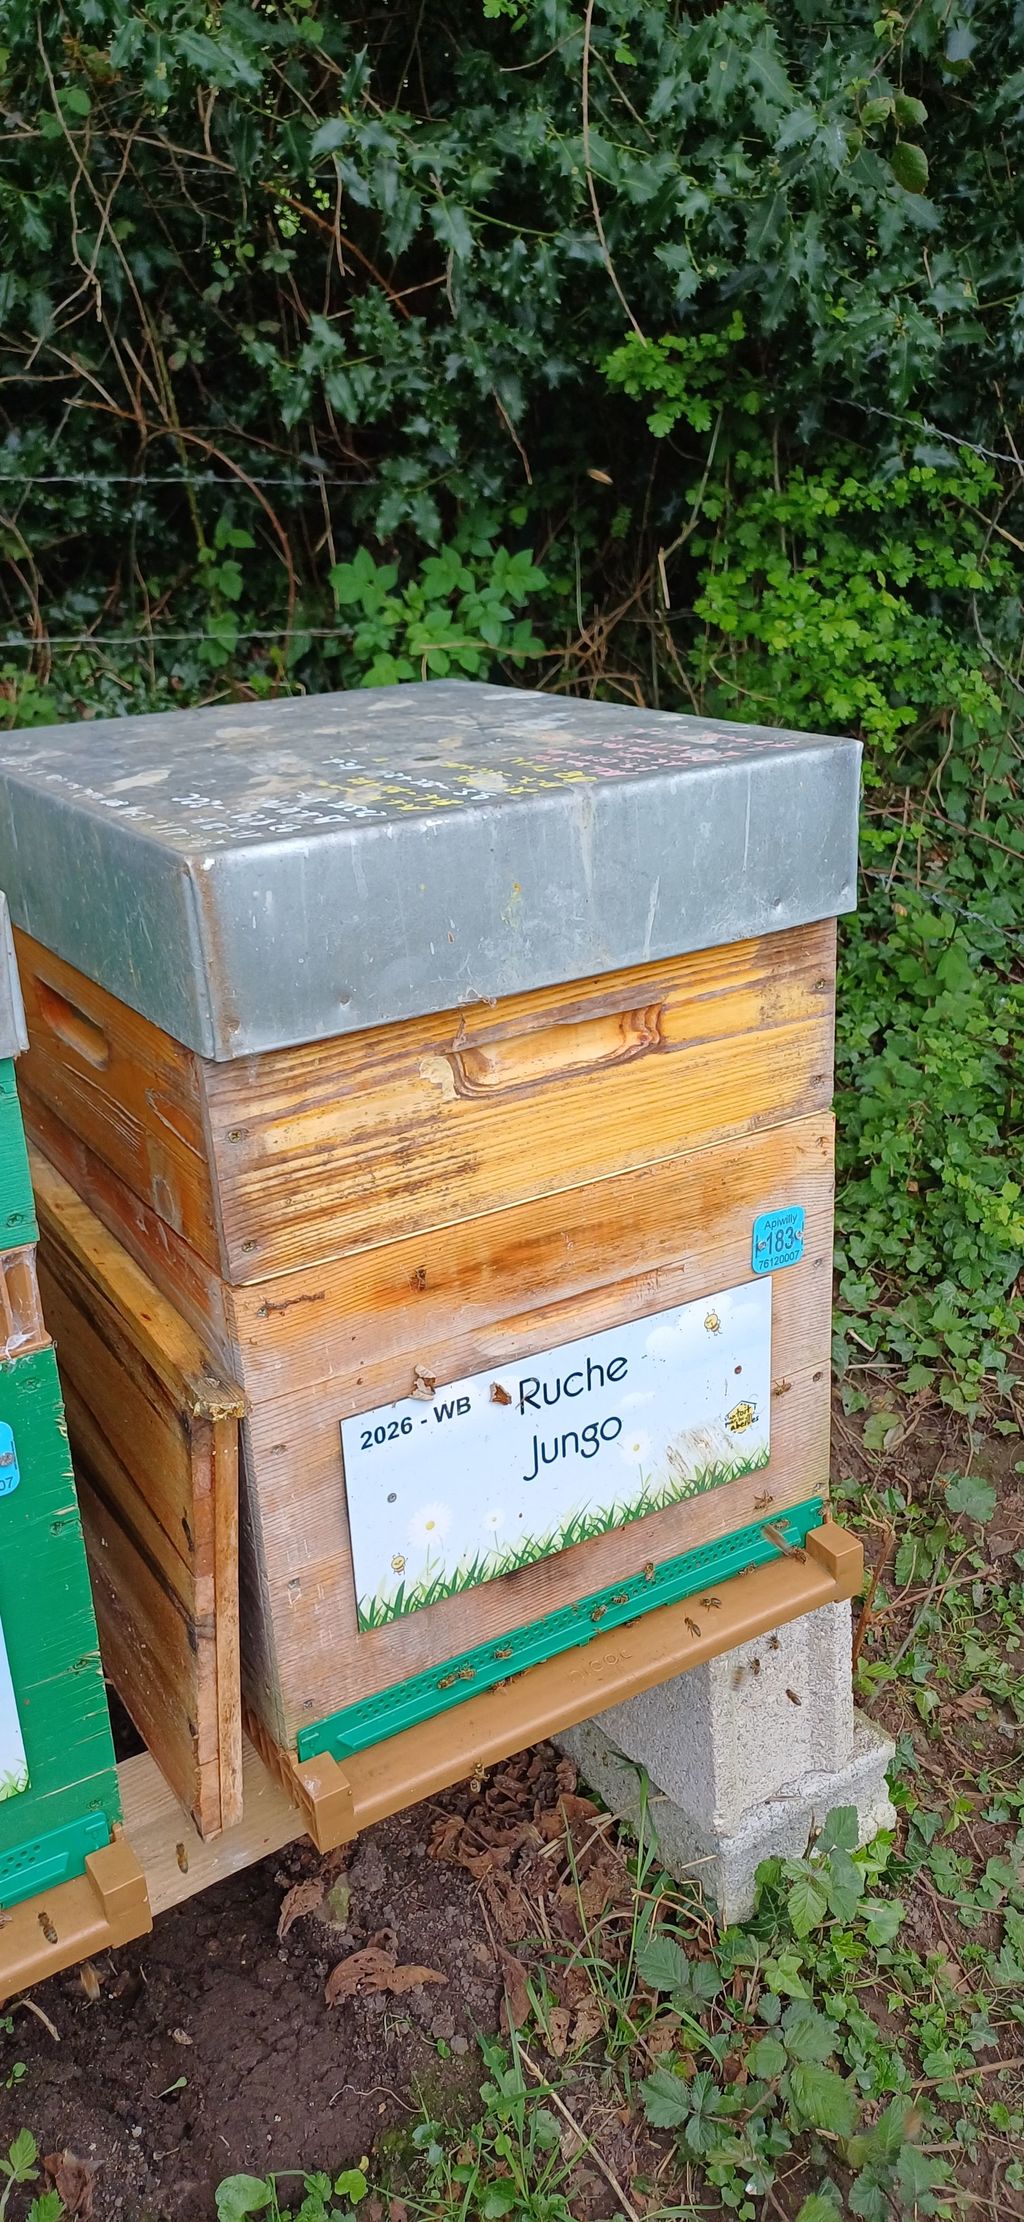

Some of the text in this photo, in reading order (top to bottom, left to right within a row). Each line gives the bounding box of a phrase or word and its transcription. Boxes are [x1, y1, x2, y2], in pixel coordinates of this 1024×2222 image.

[764, 1213, 798, 1231] Apiwilly
[766, 1226, 794, 1255] 183
[758, 1249, 801, 1270] 76120007
[519, 1357, 628, 1415] Ruche
[359, 1416, 413, 1450] 2026
[433, 1396, 471, 1423] WB
[522, 1416, 622, 1481] Jungo
